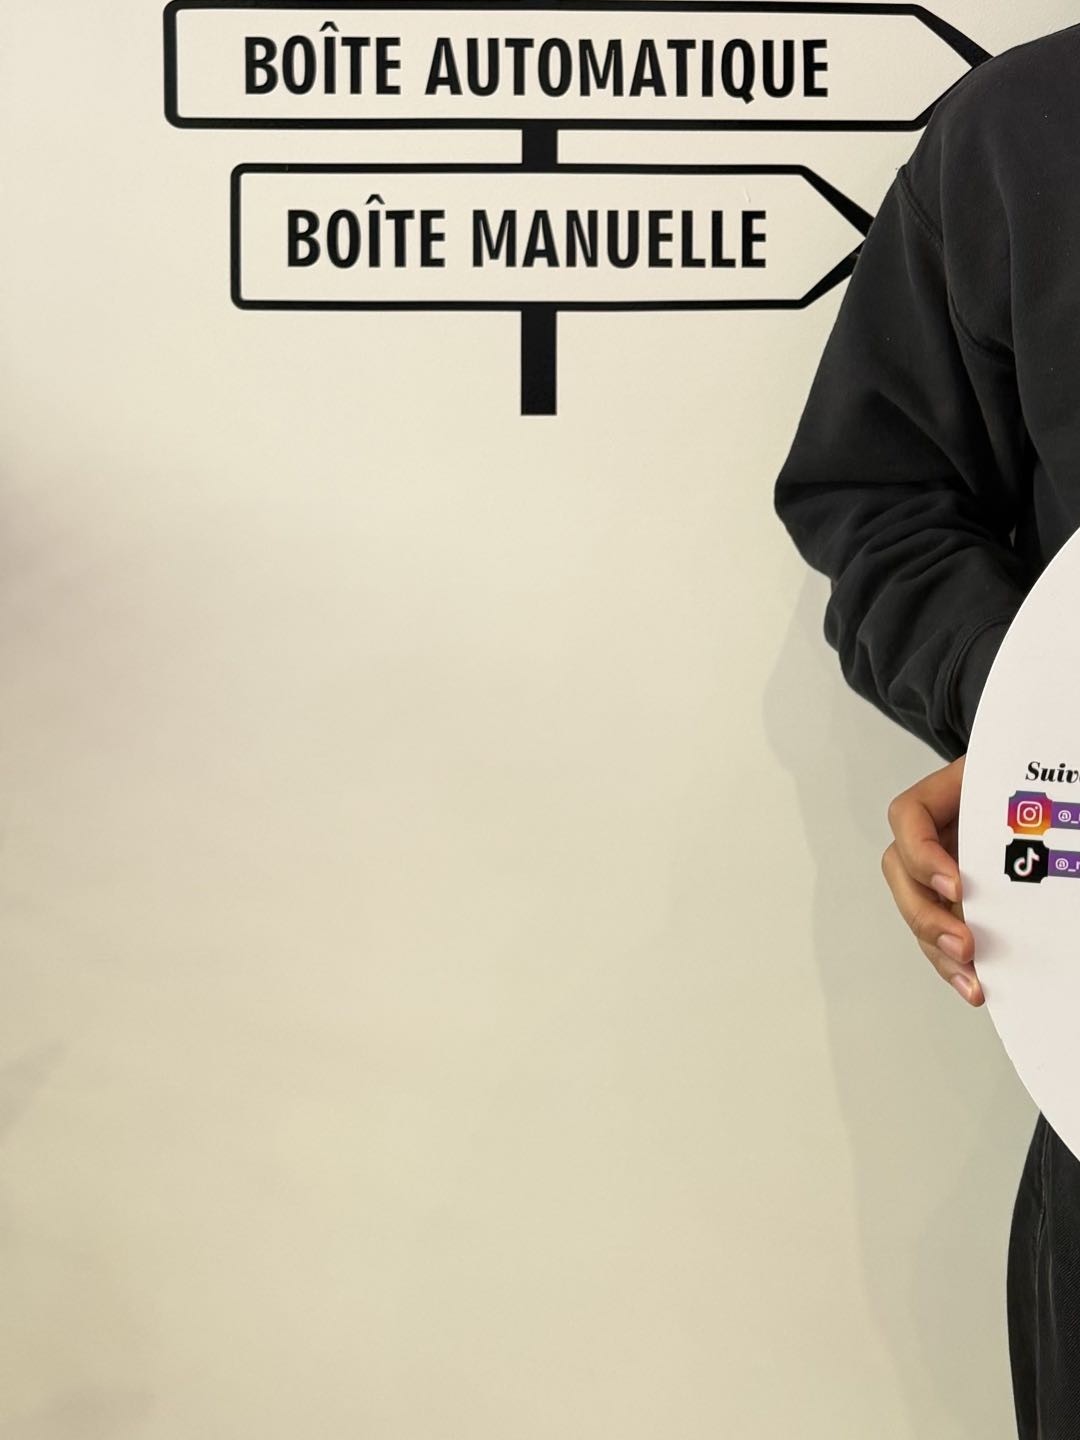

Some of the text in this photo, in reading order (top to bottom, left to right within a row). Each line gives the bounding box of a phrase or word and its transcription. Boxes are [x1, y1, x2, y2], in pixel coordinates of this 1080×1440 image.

[244, 21, 828, 104] BOÎTE AUTOMATIQUE
[287, 193, 767, 269] BOÎTE MANUELLE
